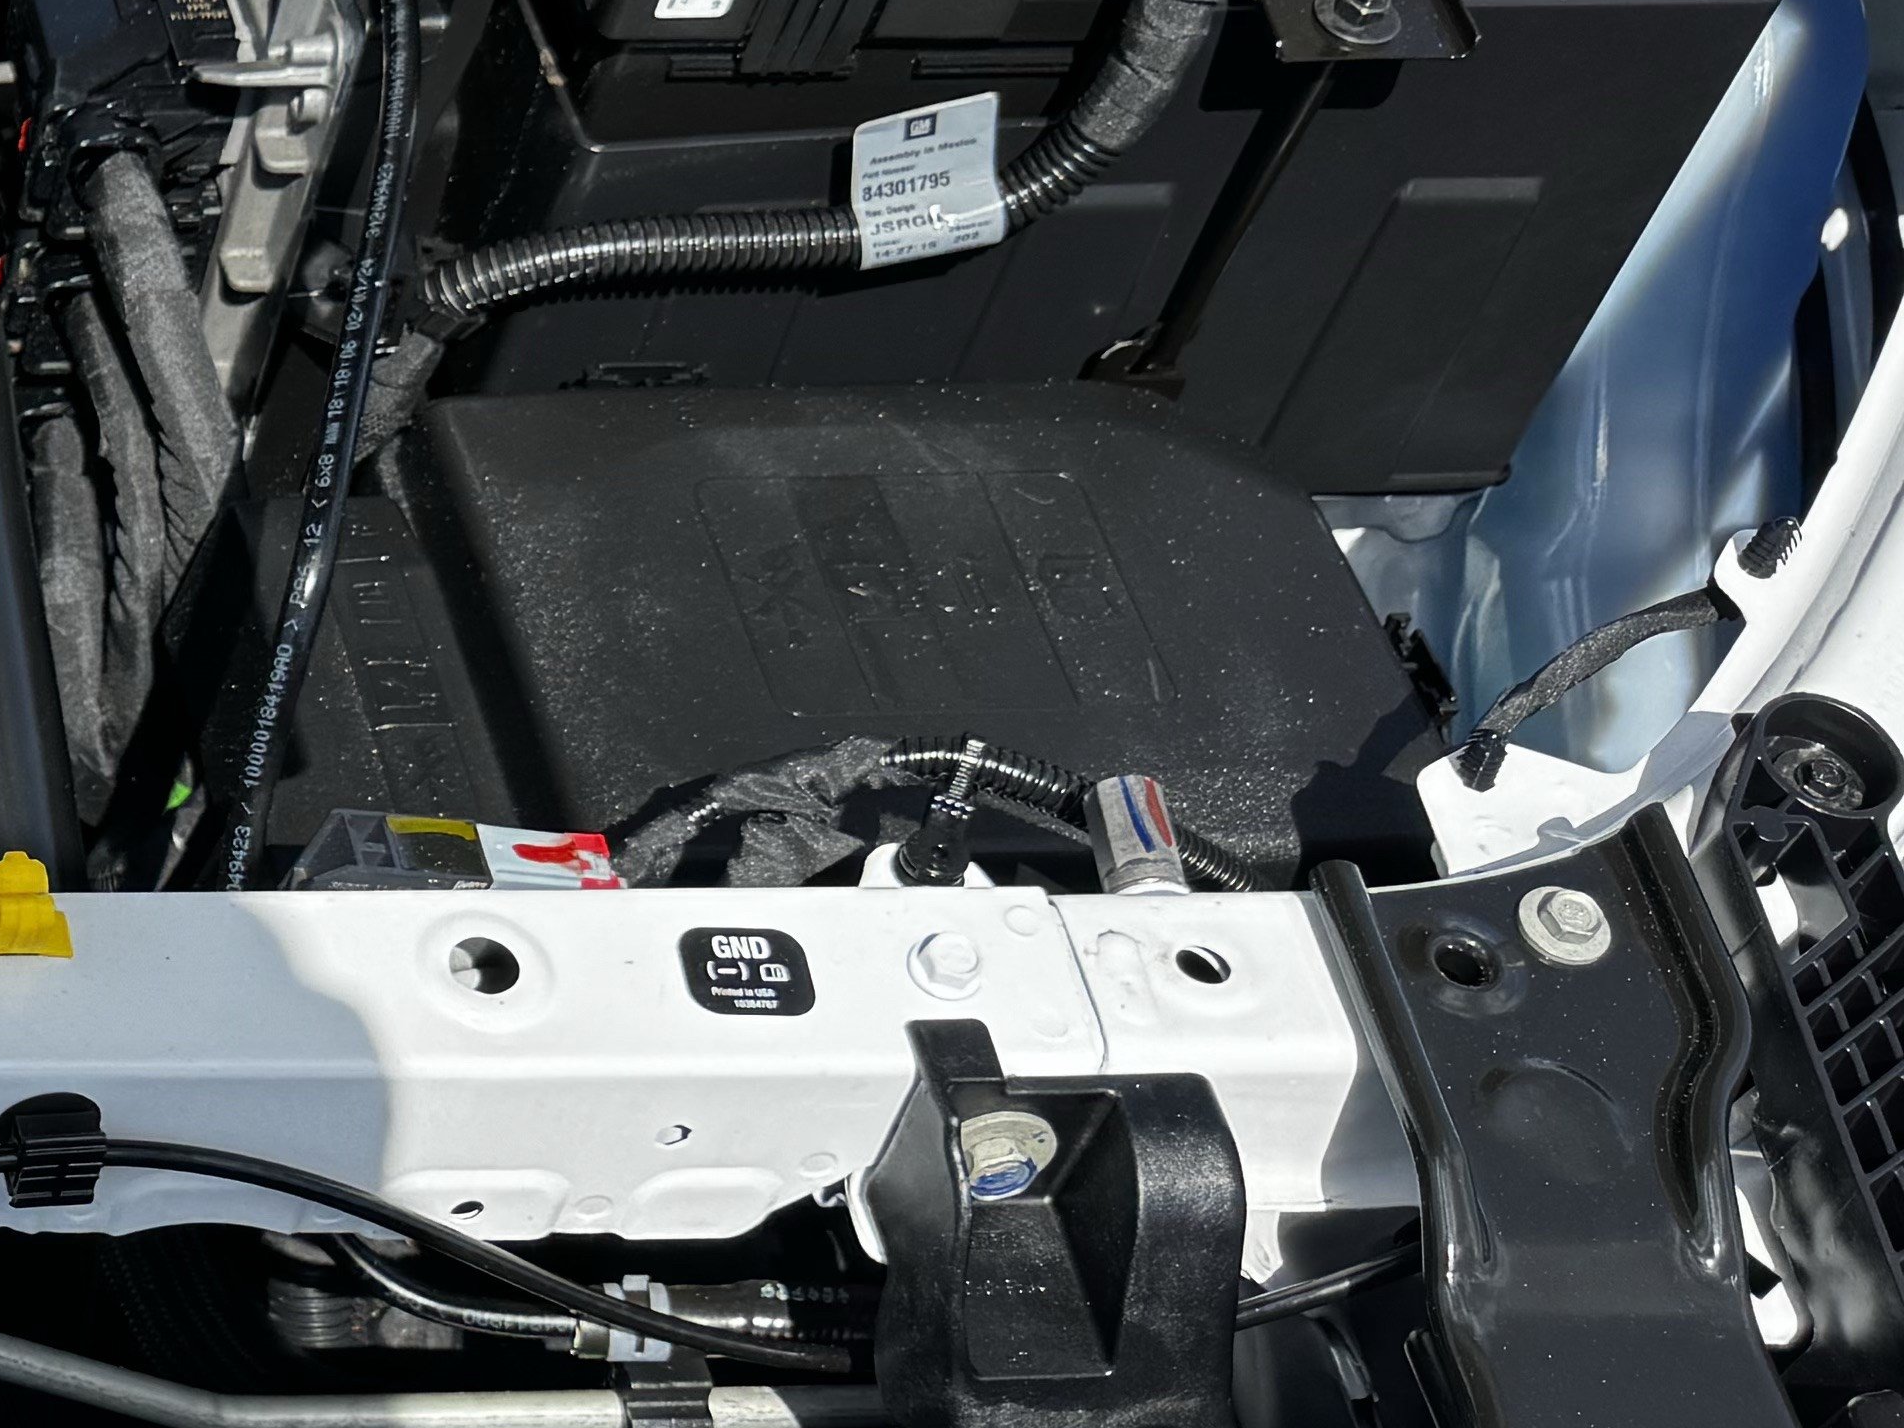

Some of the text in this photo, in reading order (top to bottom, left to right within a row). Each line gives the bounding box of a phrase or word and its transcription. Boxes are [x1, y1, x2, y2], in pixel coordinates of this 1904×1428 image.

[862, 171, 950, 201] 84301795
[315, 451, 334, 488] 6x8
[712, 935, 771, 959] GND
